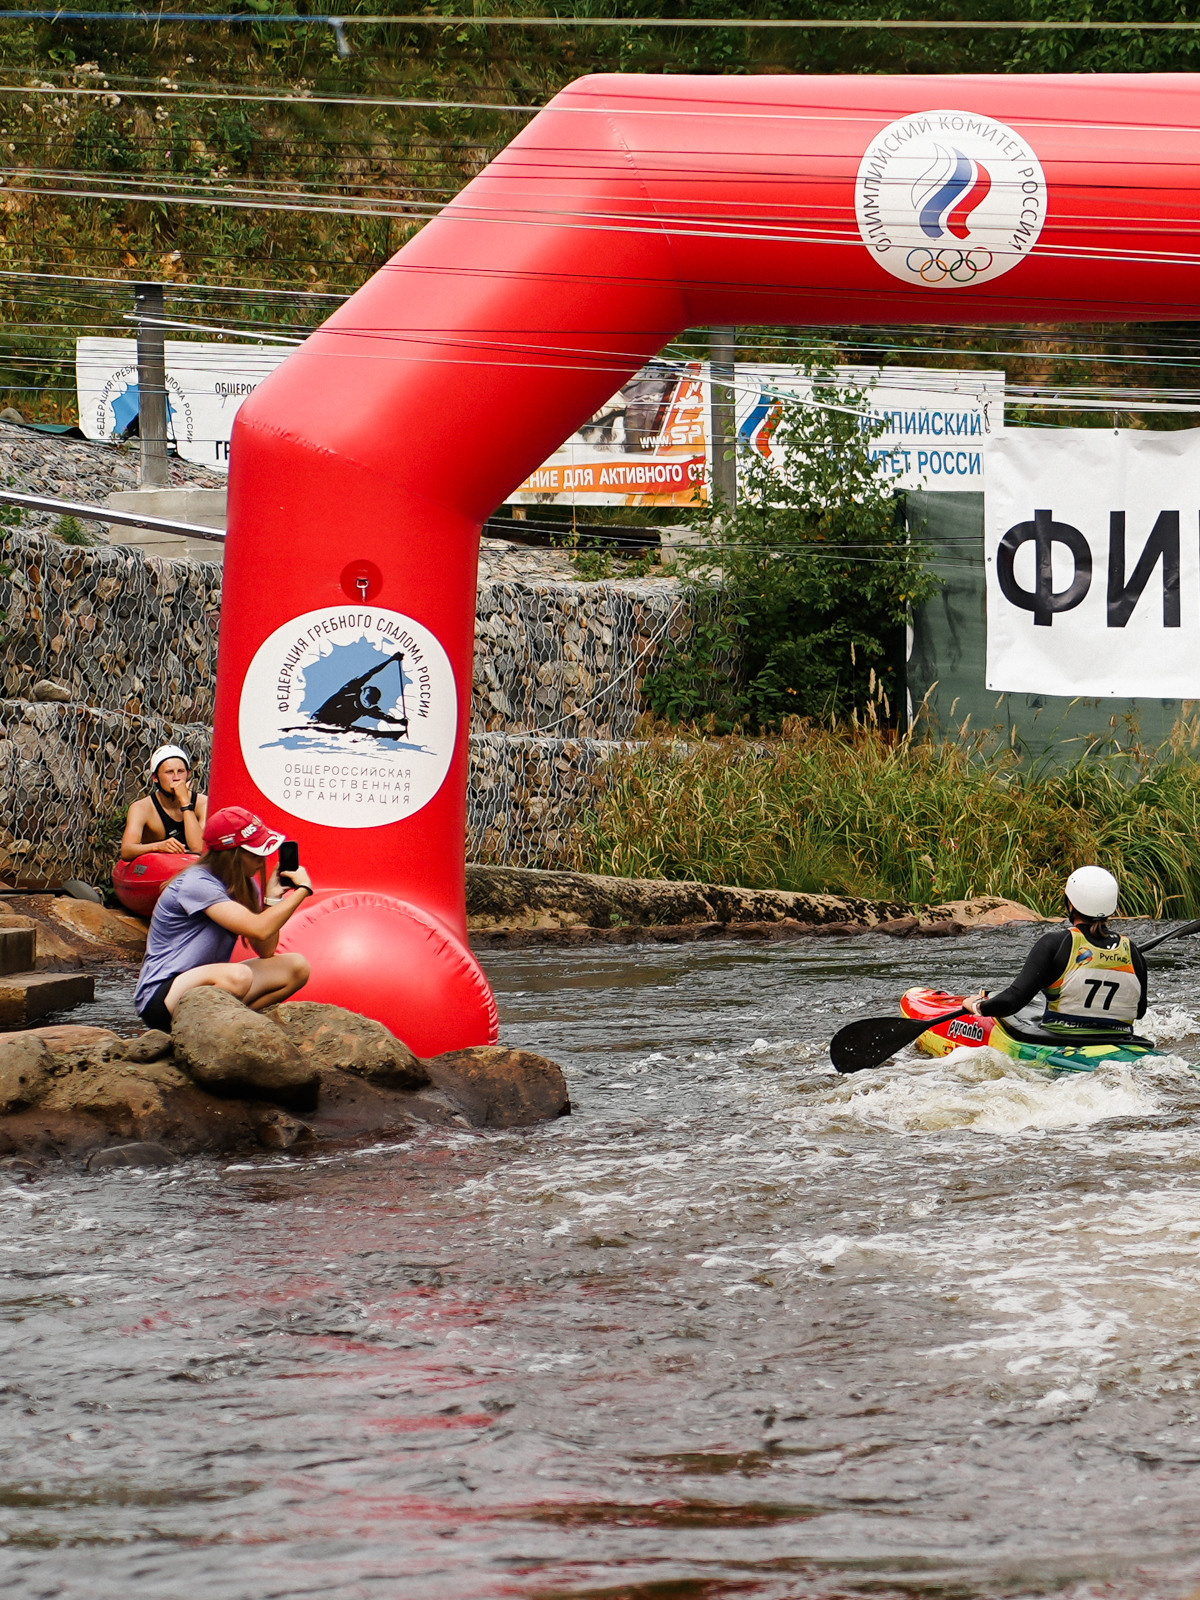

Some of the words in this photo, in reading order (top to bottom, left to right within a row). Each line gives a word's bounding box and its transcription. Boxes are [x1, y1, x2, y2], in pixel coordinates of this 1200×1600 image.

[863, 116, 932, 253] ОЛИМПИЙСКИЙ
[938, 116, 1026, 162] КОМИТЕТ
[1008, 166, 1039, 251] РОССИИ
[112, 366, 138, 382] ГРЕБН
[165, 374, 185, 401] АЛОМА
[183, 402, 193, 443] РОССИИ
[918, 451, 982, 475] РОССИ
[563, 469, 594, 489] ДЛЯ
[599, 464, 683, 485] АКТИВНОГО
[277, 637, 309, 713] ФЕДЕРАЦИЯ
[307, 614, 372, 642] ГРЕБНОГО
[376, 618, 424, 665] СЛАЛОМА
[417, 666, 432, 719] РОССИИ
[284, 763, 411, 778] ОБЩЕРОССИЙСКАЯ
[283, 776, 410, 792] ОБЩЕСТВЕННАЯ
[282, 789, 410, 804] ОРГАНИЗАЦИЯ
[241, 823, 258, 839] RUS
[1084, 979, 1120, 1011] 77
[947, 1019, 984, 1042] pyranha
